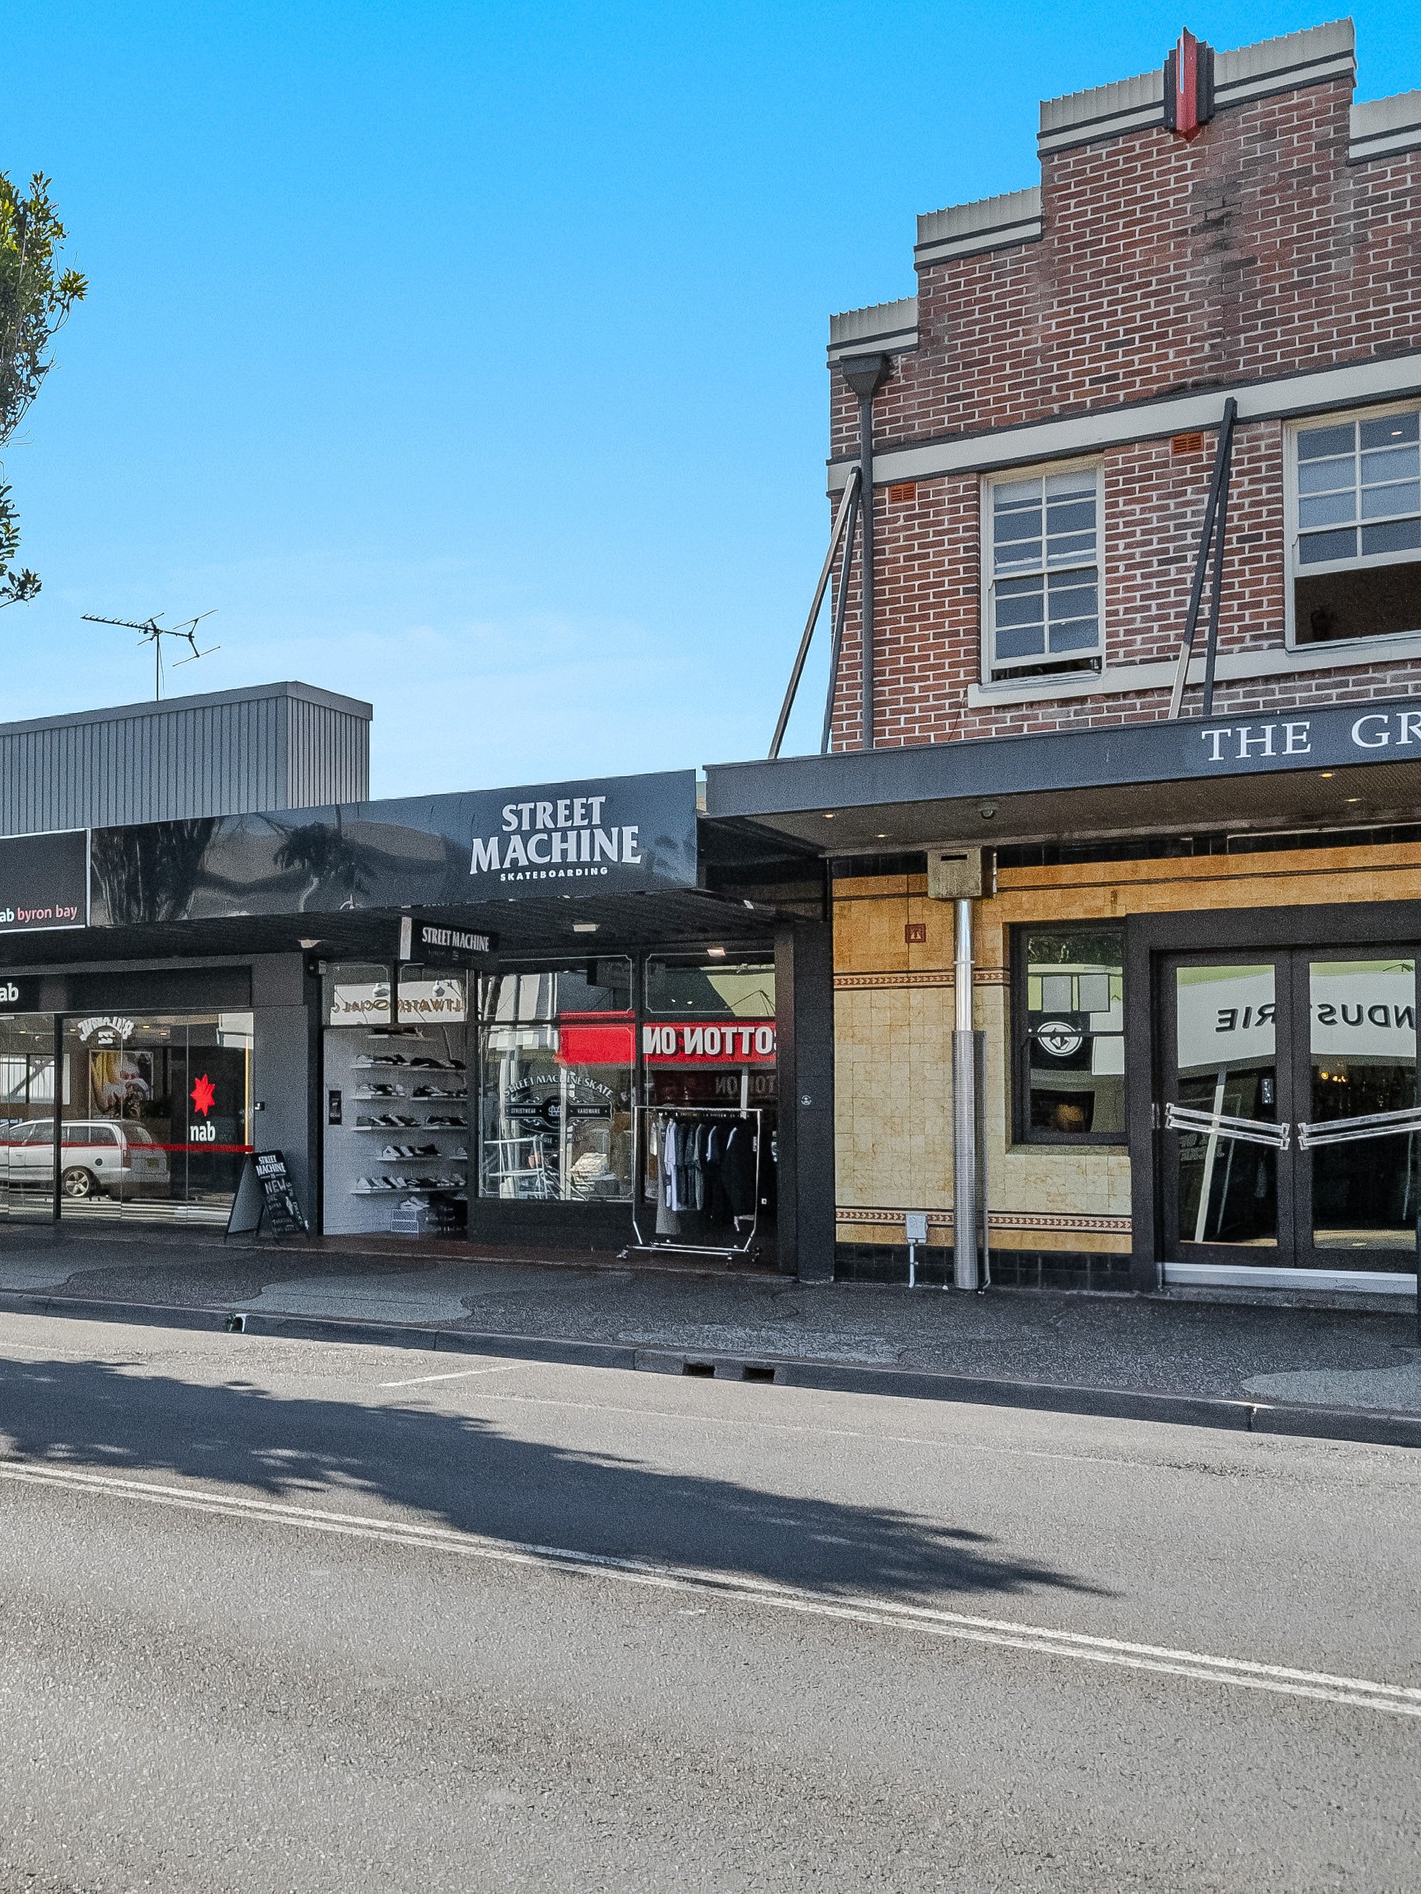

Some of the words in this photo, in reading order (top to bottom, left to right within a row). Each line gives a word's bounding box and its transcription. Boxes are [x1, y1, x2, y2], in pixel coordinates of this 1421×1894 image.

[1201, 721, 1311, 761] THE
[1351, 711, 1421, 748] GR
[501, 796, 606, 832] STREET
[469, 825, 642, 875] MACHINE
[500, 866, 609, 882] SKATEBOARDING
[17, 906, 53, 923] byron
[55, 904, 78, 921] bay
[421, 926, 452, 946] STREET
[452, 931, 490, 953] MACHINE
[536, 1073, 582, 1085] MACINE
[584, 1077, 614, 1099] SKATE
[189, 1121, 216, 1143] nab
[255, 1162, 287, 1176] MACHINE
[258, 1155, 278, 1165] STREET
[264, 1178, 287, 1195] NEW
